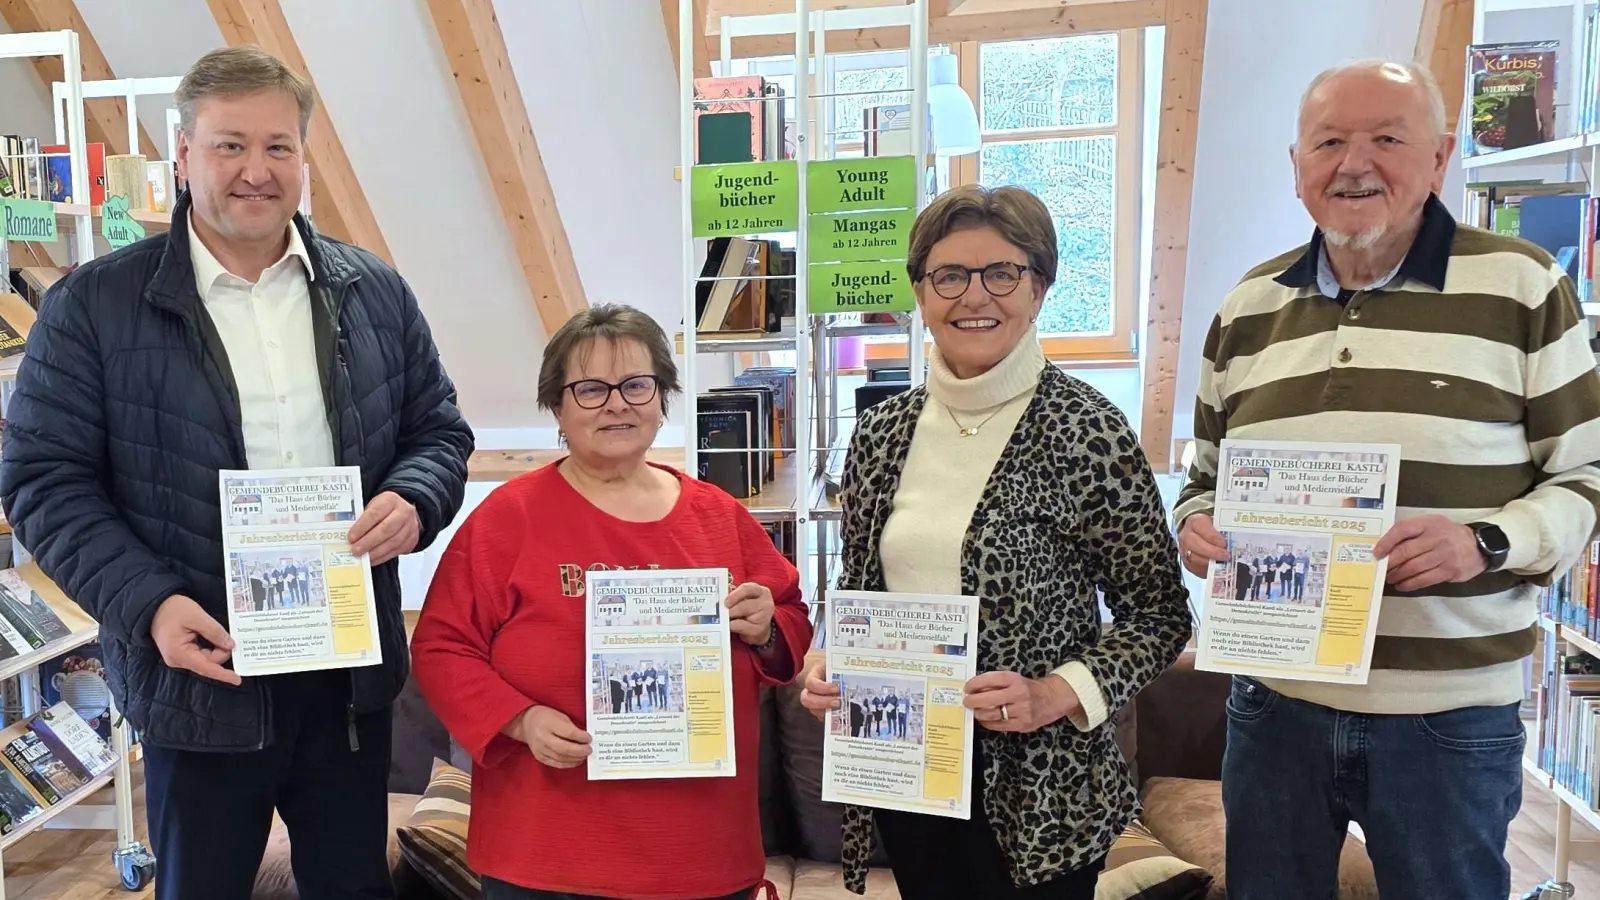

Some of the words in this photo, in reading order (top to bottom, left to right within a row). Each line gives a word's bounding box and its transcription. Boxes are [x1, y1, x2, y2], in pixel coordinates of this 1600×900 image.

[715, 171, 780, 192] Jugend-
[836, 169, 888, 186] Young
[719, 190, 775, 208] bücher
[840, 187, 885, 203] Adult
[5, 206, 52, 236] Romane
[107, 207, 124, 221] New
[708, 221, 721, 230] ab
[725, 219, 739, 230] 12
[742, 218, 783, 229] Jahren
[833, 218, 896, 234] Mangas
[108, 227, 129, 241] Adult
[832, 240, 844, 249] ab
[848, 239, 859, 248] 12
[862, 237, 897, 247] Jahren
[831, 271, 898, 290] Jugend-
[836, 290, 893, 306] bücher
[1347, 463, 1382, 472] KASTL
[1338, 475, 1368, 483] Bücher
[1234, 512, 1327, 528] Jahresbericht
[1331, 521, 1366, 532] 2025
[240, 533, 317, 544] Jahresbericht
[320, 532, 346, 540] 2025
[936, 614, 965, 622] KASTL
[895, 622, 913, 630] Haus
[928, 624, 954, 632] Bücher
[602, 634, 678, 644] Jahresbericht
[844, 657, 923, 671] Jahresbericht
[926, 665, 954, 676] 2025
